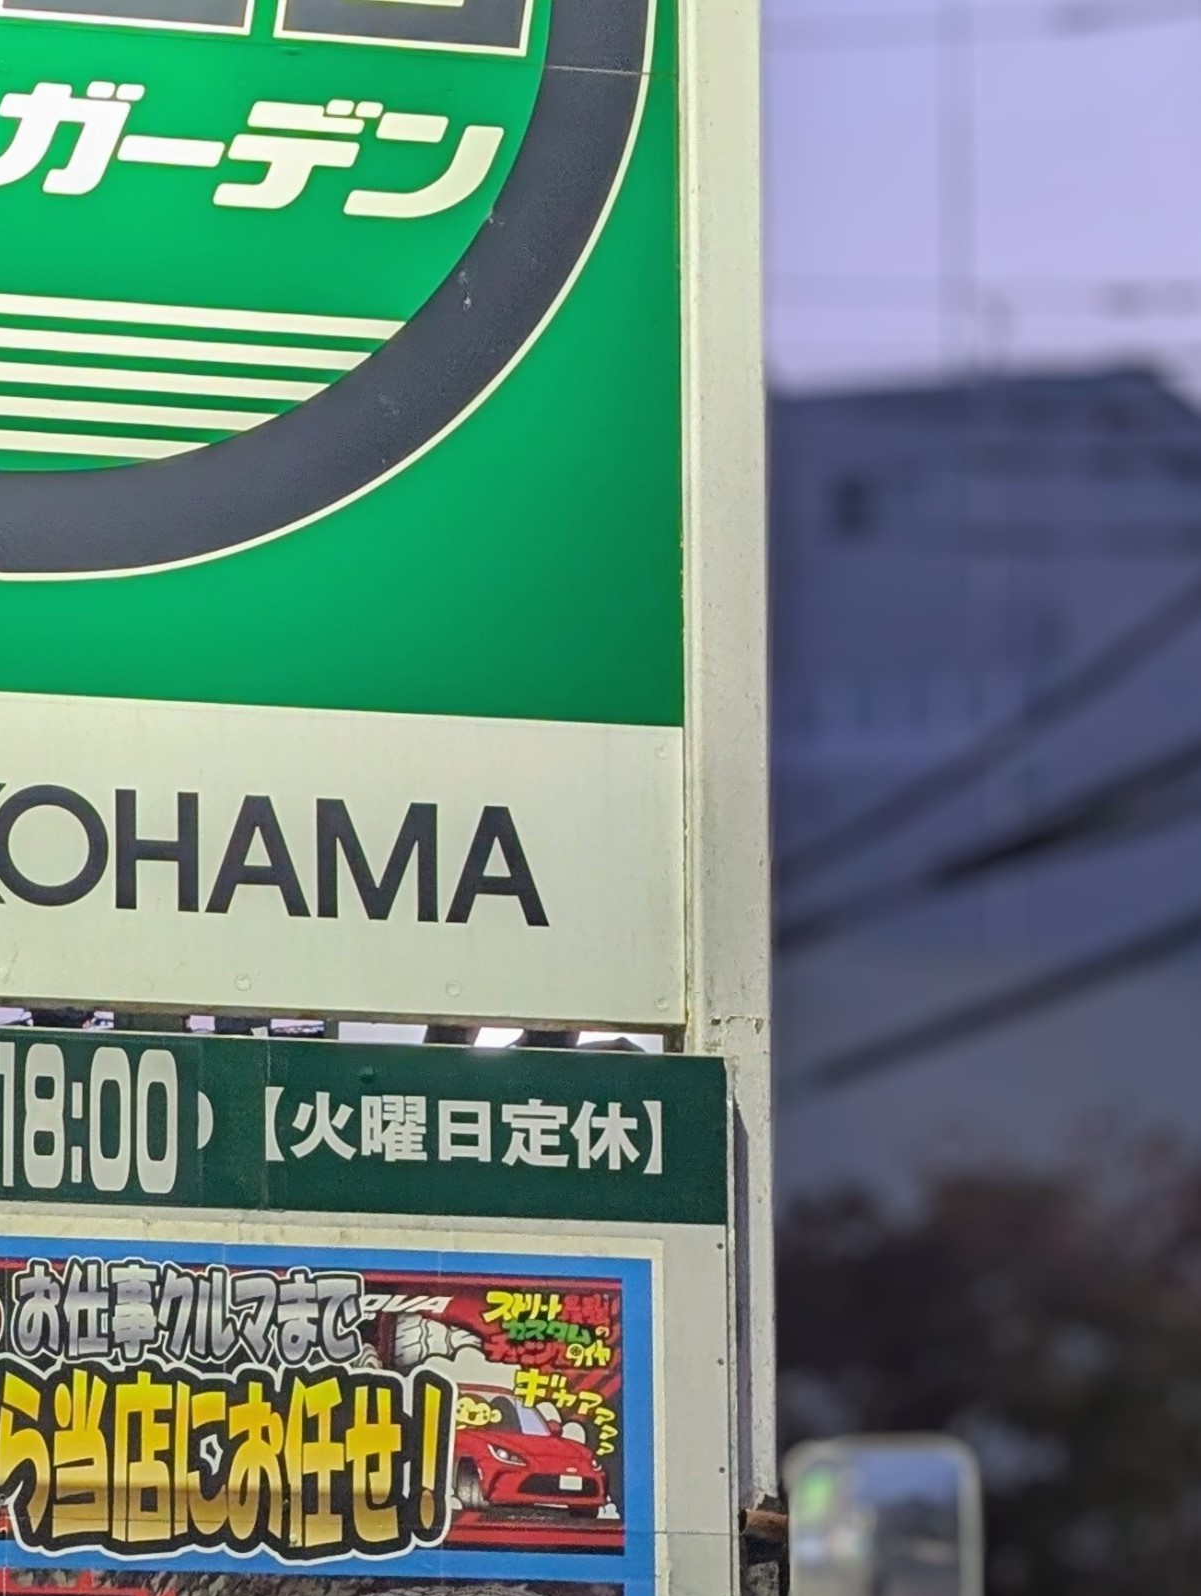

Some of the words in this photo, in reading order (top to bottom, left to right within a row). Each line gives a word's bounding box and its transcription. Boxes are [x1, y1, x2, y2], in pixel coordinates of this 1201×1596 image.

[260, 1095, 666, 1176] 【火曜日定休】
[16, 1259, 362, 1362] お仕事クルマまで
